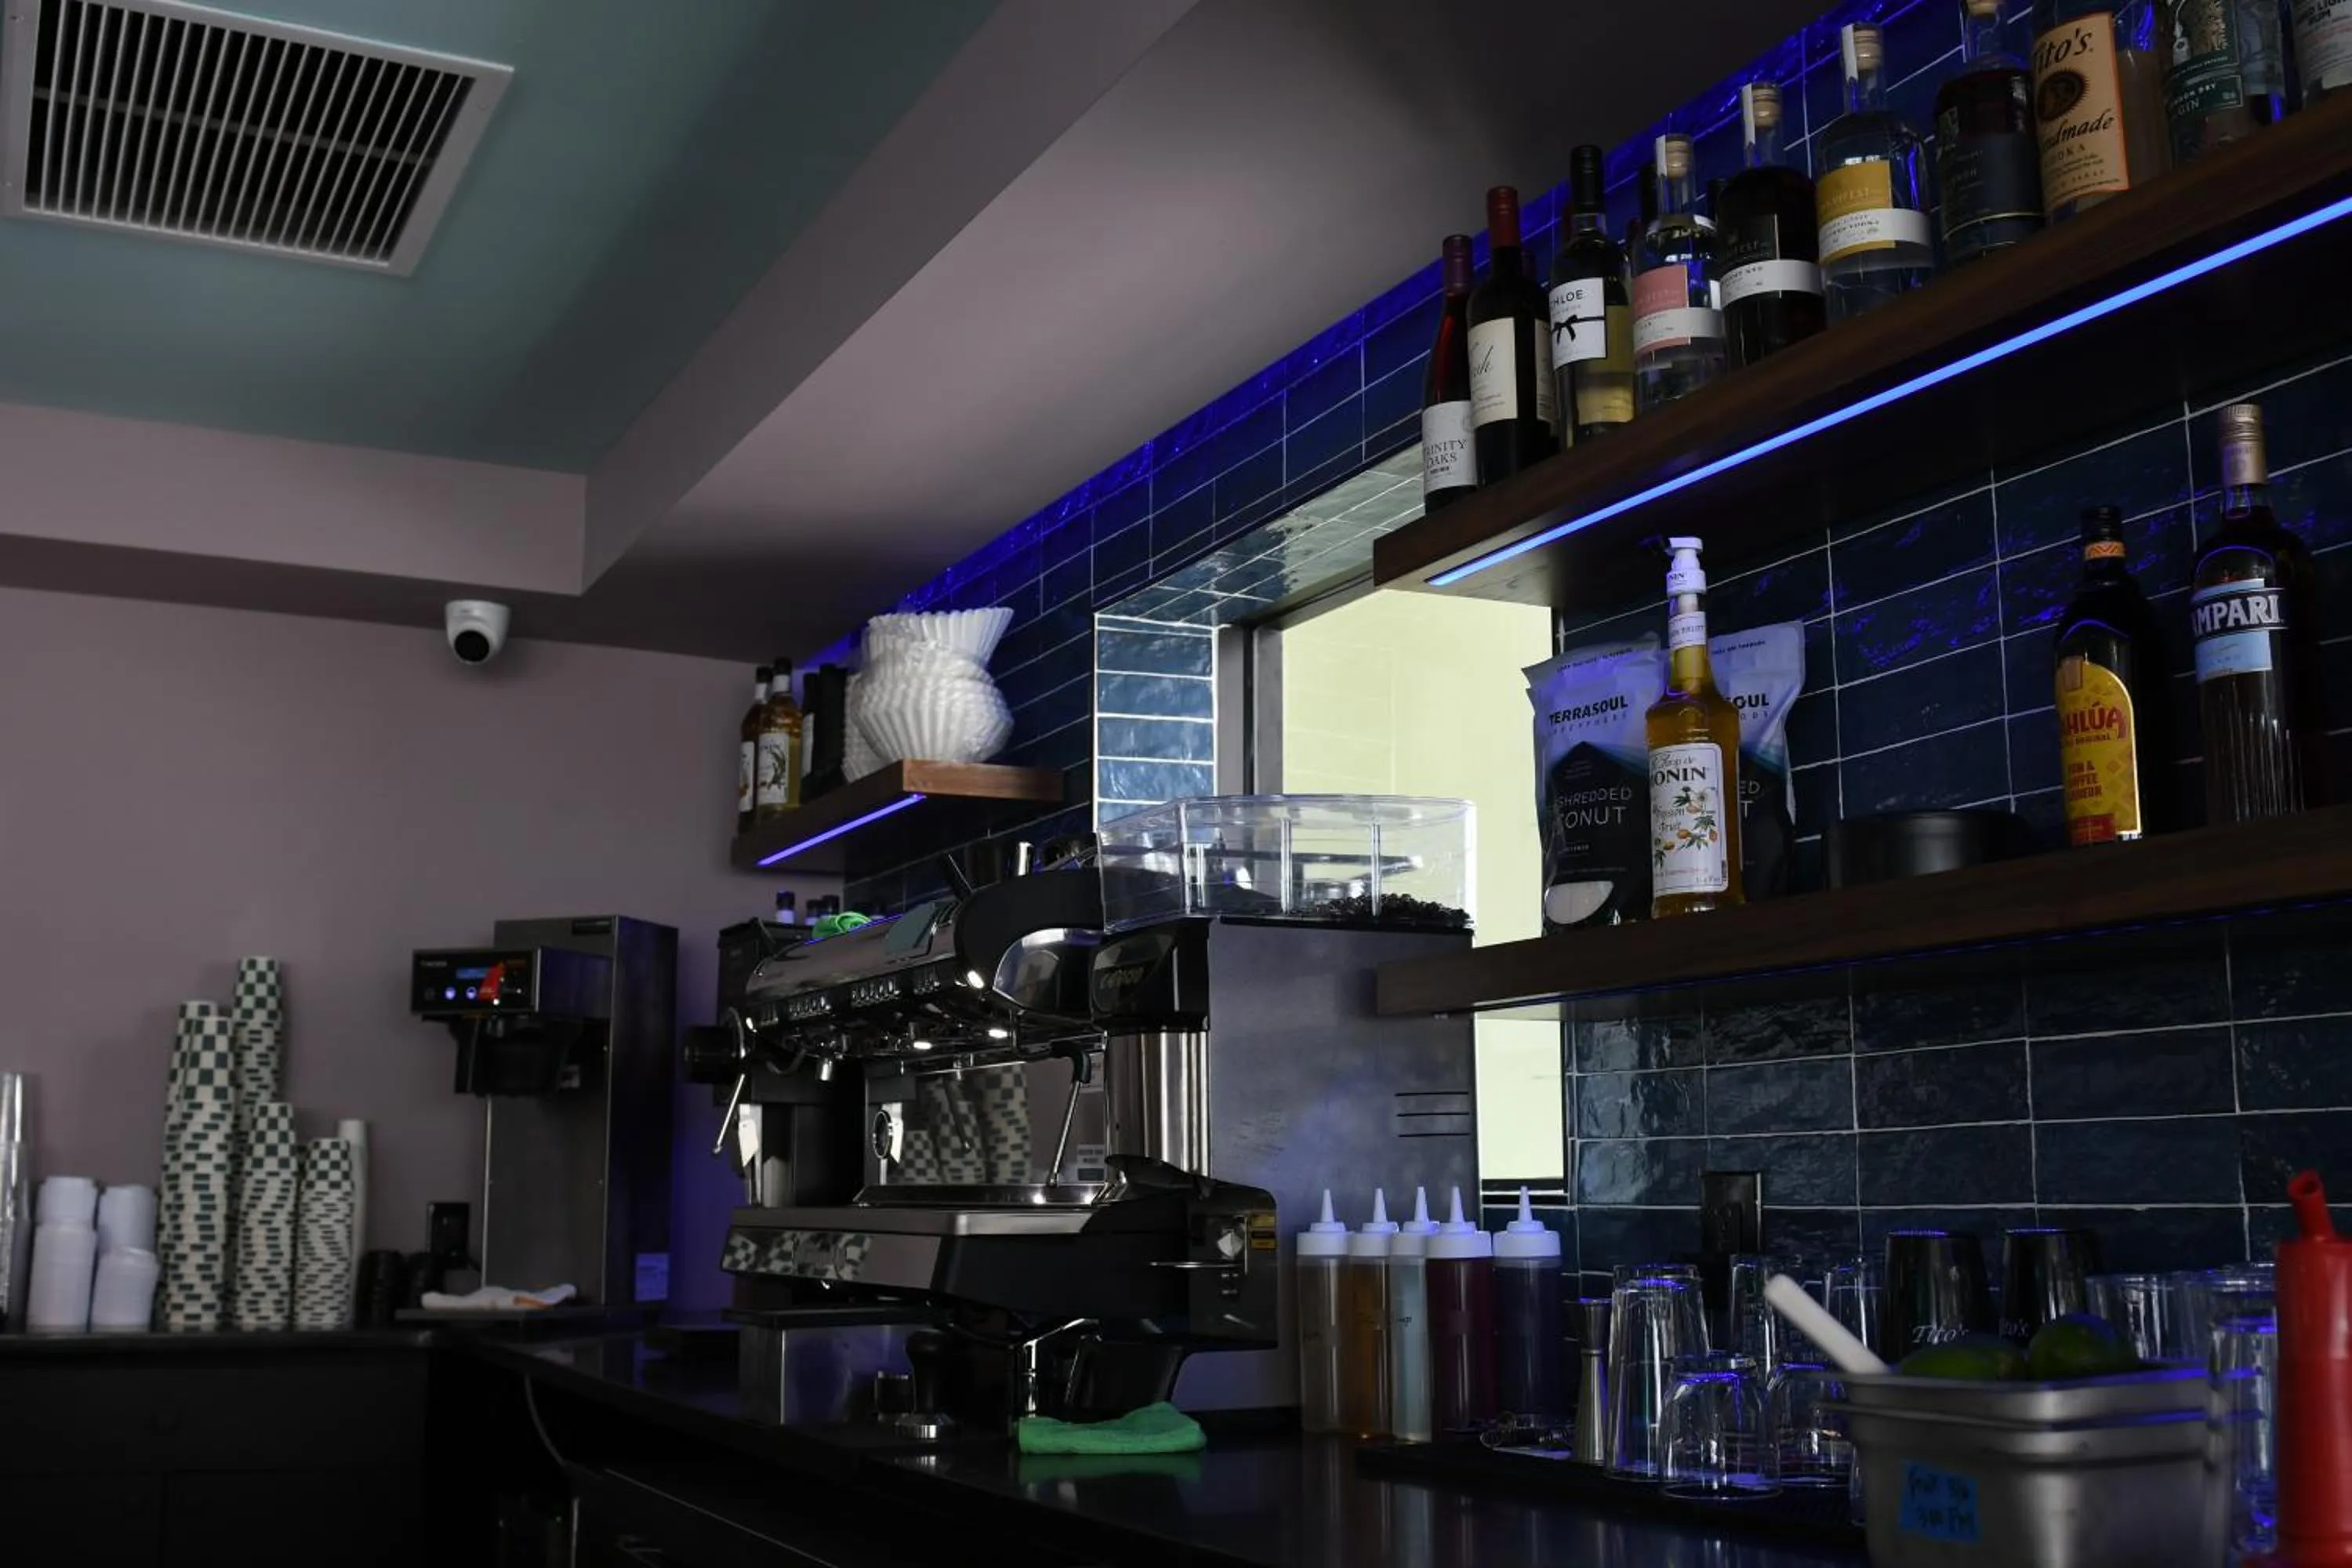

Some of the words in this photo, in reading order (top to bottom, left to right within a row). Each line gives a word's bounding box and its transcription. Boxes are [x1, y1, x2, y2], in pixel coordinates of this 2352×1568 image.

[2177, 96, 2200, 116] GIN
[2190, 593, 2281, 637] MPARI
[1549, 695, 1628, 727] TERRASOUL
[1726, 693, 1769, 710] OUL
[2064, 700, 2127, 739] HLÚA
